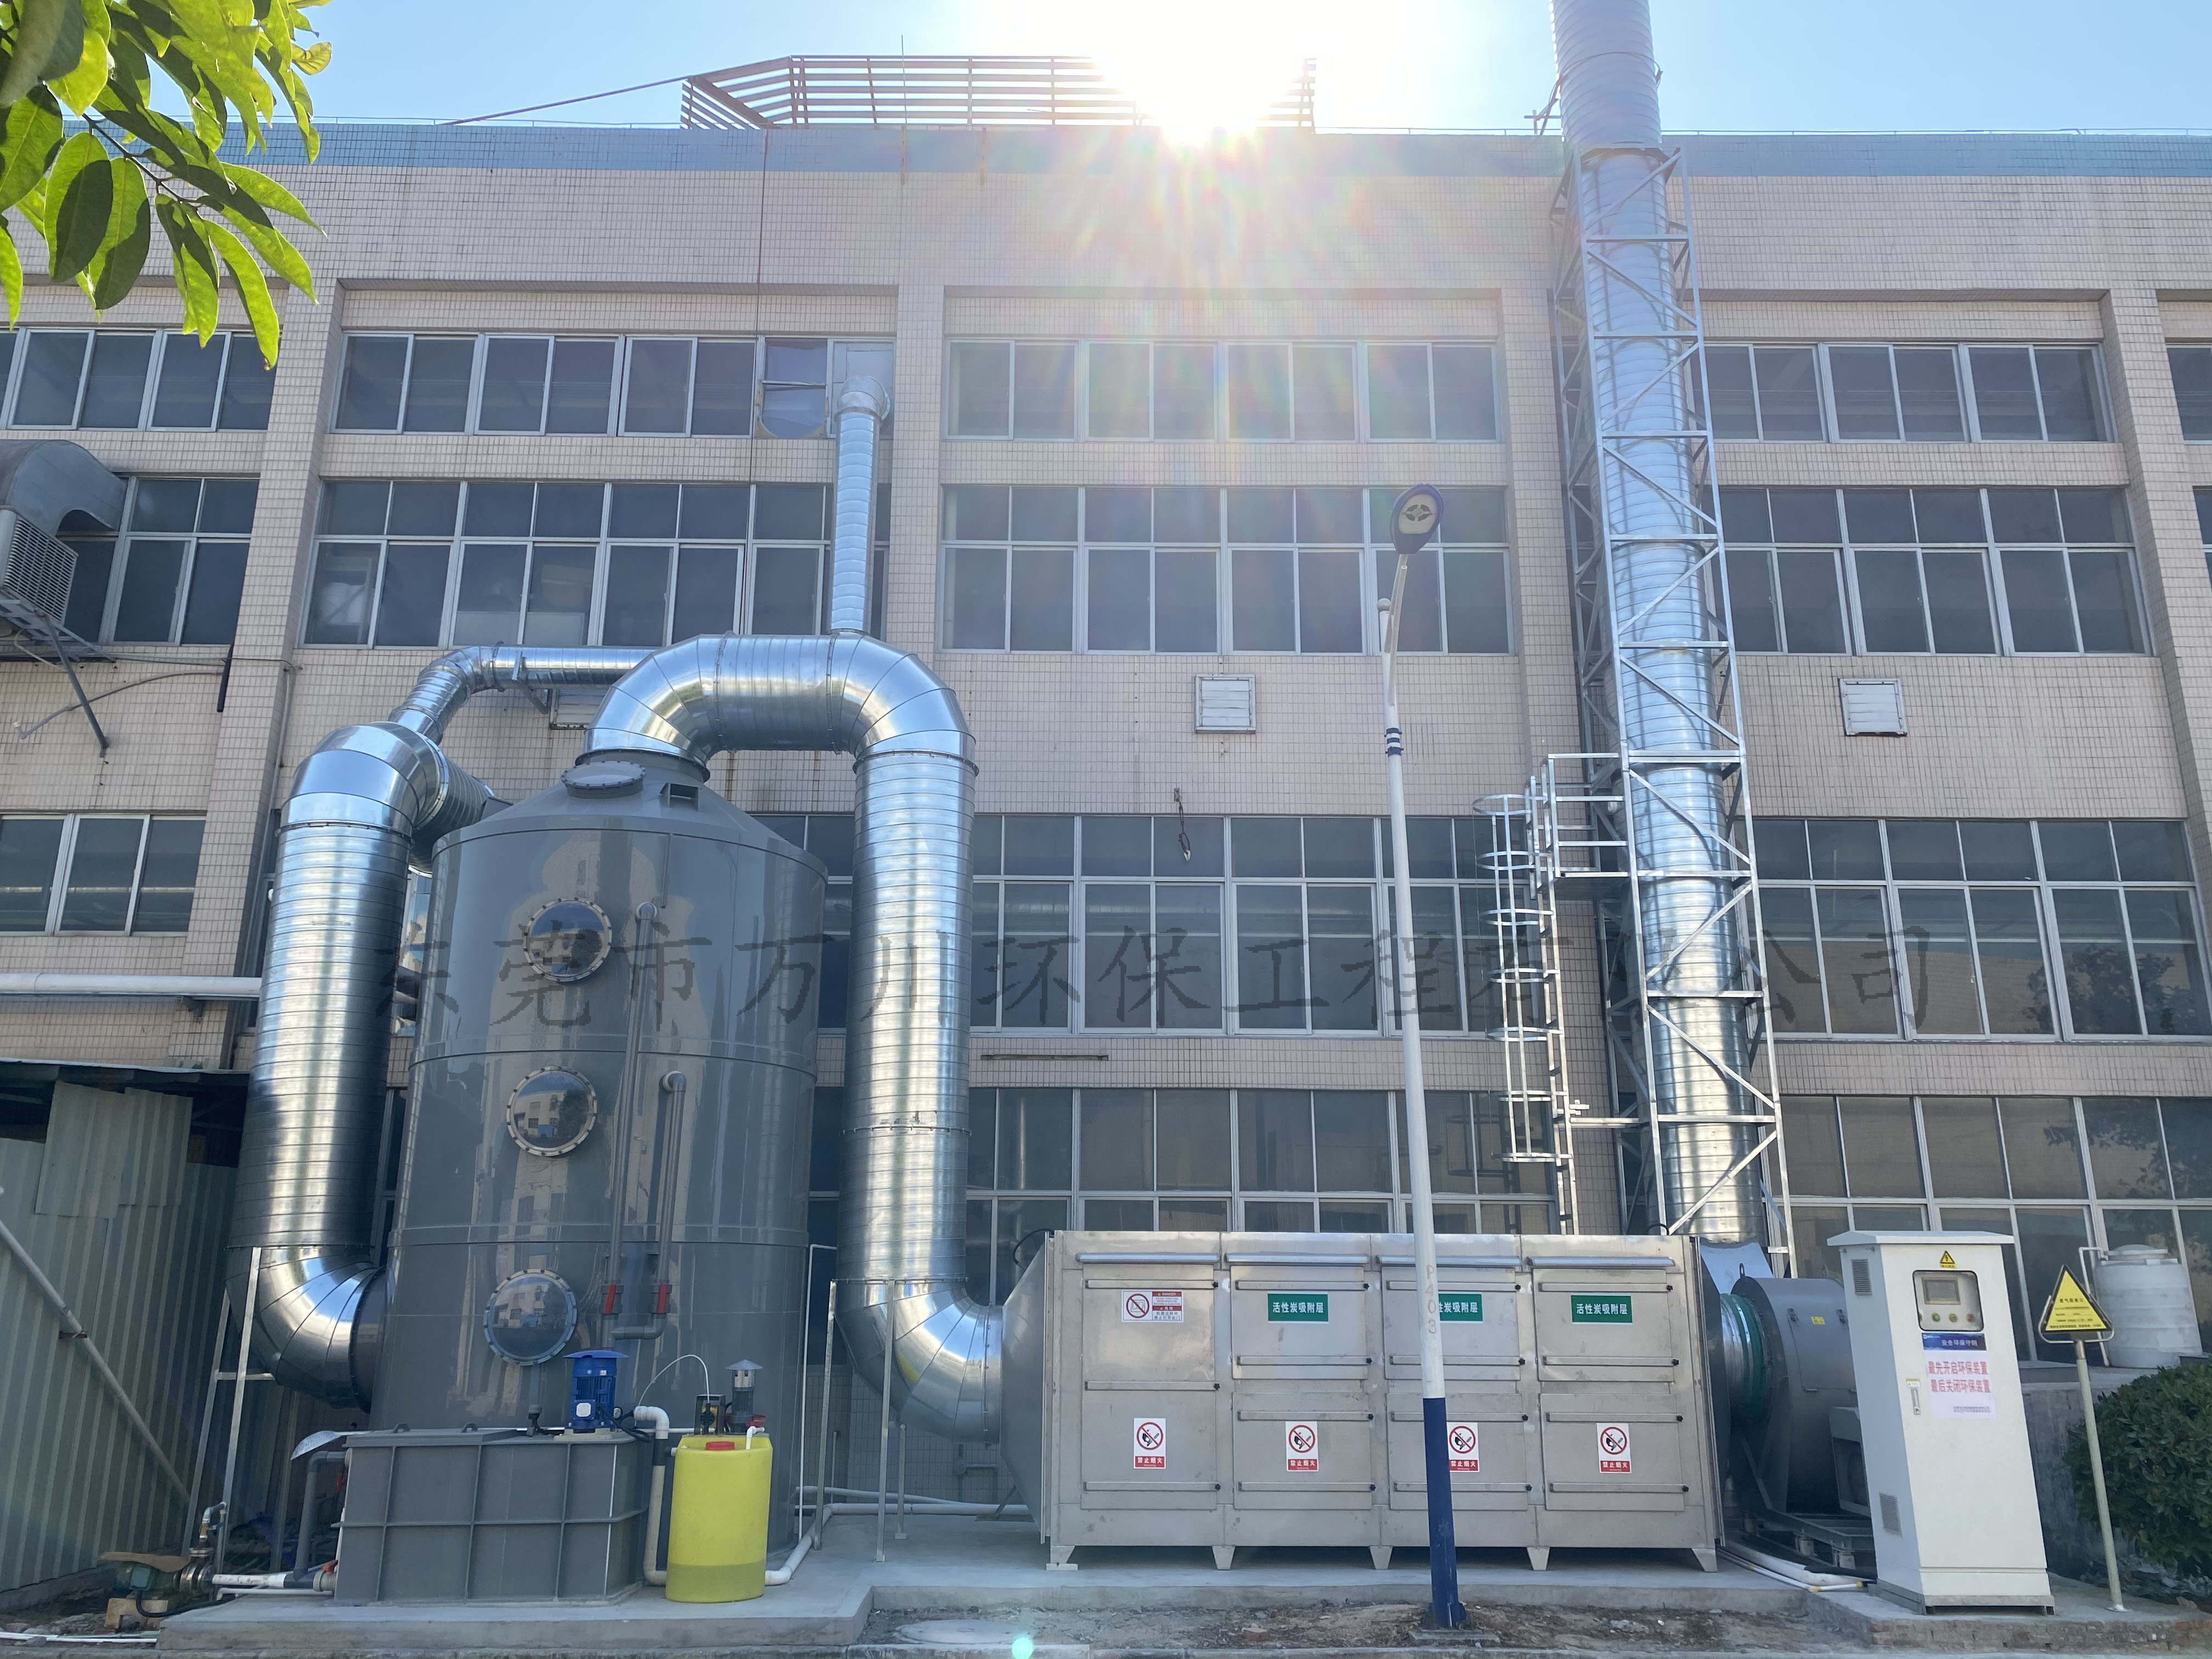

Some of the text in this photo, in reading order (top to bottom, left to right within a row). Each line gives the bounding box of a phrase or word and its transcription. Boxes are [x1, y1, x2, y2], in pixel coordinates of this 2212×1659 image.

[1273, 1302, 1324, 1313] 活性炭吸附层
[1438, 1302, 1478, 1313] 性炭吸附层
[1576, 1304, 1627, 1314] 活性炭吸附层
[1928, 1361, 1988, 1375] 最先开启环保装置
[1931, 1379, 1991, 1393] 最后关闭环保装置
